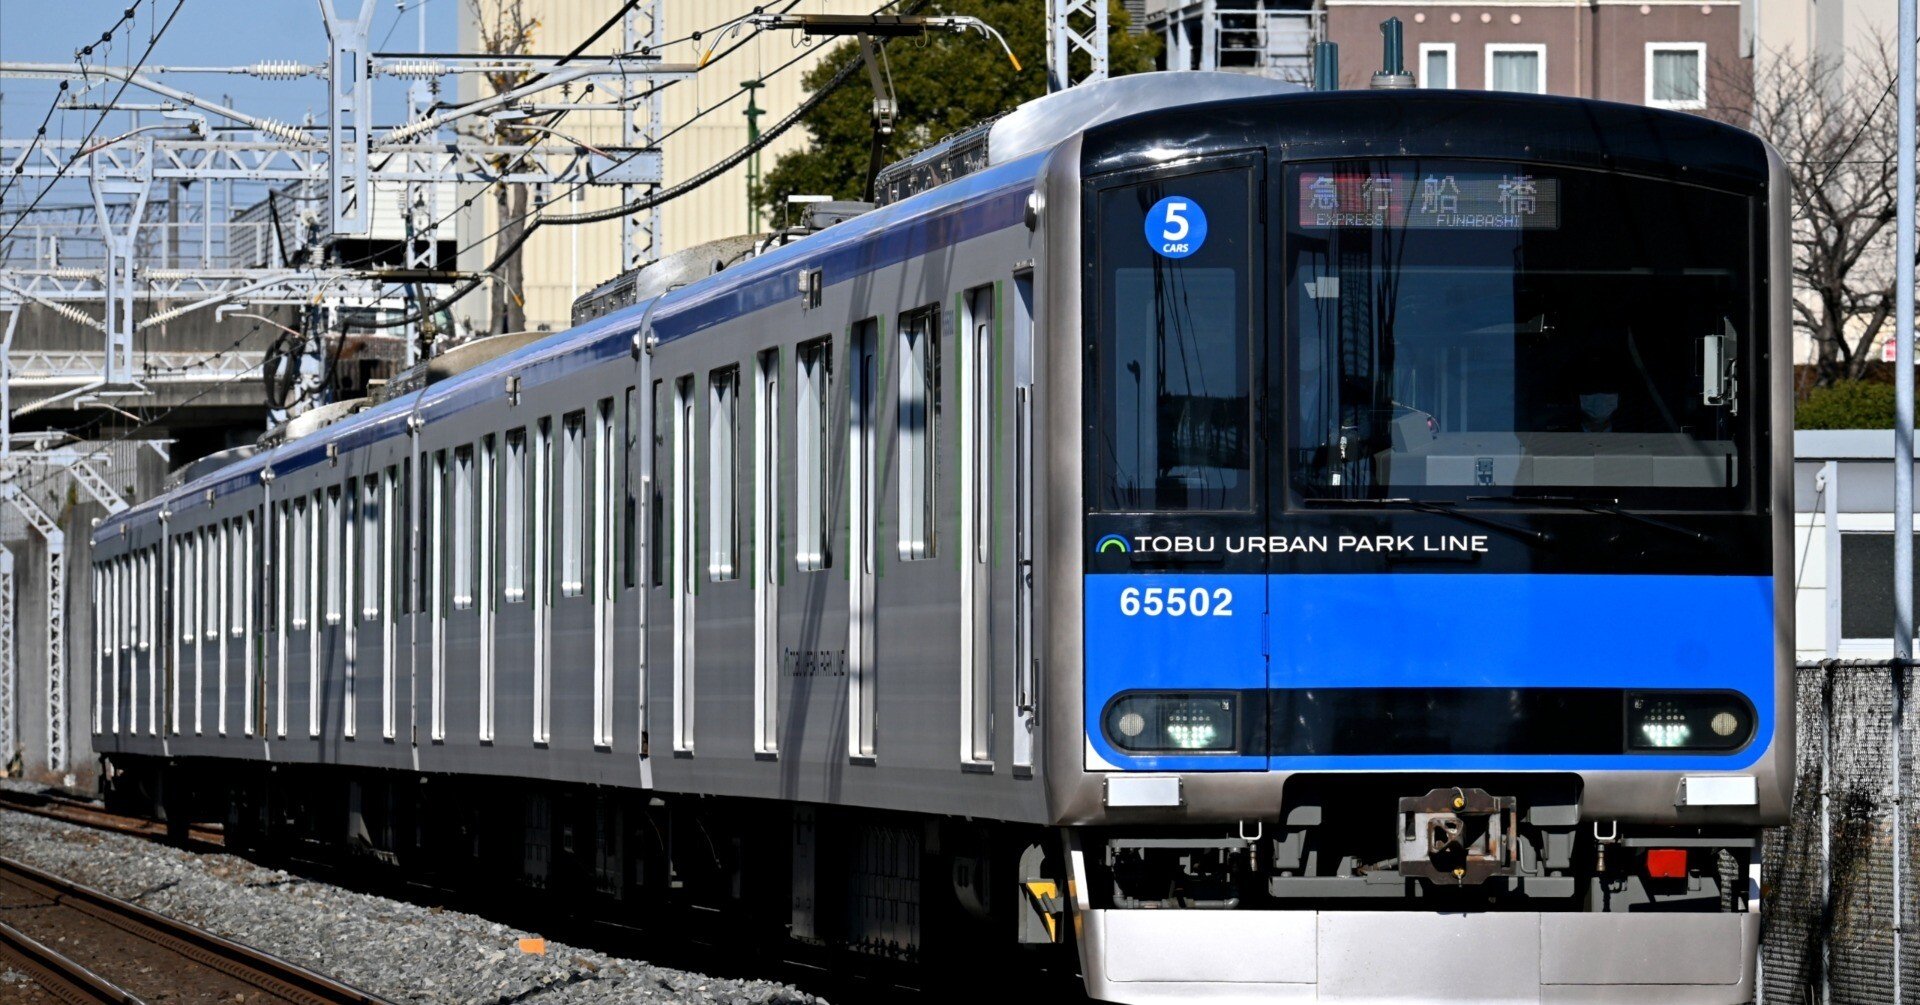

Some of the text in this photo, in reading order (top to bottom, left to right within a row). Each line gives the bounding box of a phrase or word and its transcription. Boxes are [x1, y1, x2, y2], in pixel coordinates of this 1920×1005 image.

[1308, 174, 1538, 215] 急行 船橋
[1163, 202, 1189, 241] 5
[1316, 213, 1521, 227] EXPRESS FUNABASHI
[1162, 243, 1189, 253] CARS
[1134, 536, 1489, 553] TOBU URBAN PARK LINE
[1120, 587, 1233, 616] 65502
